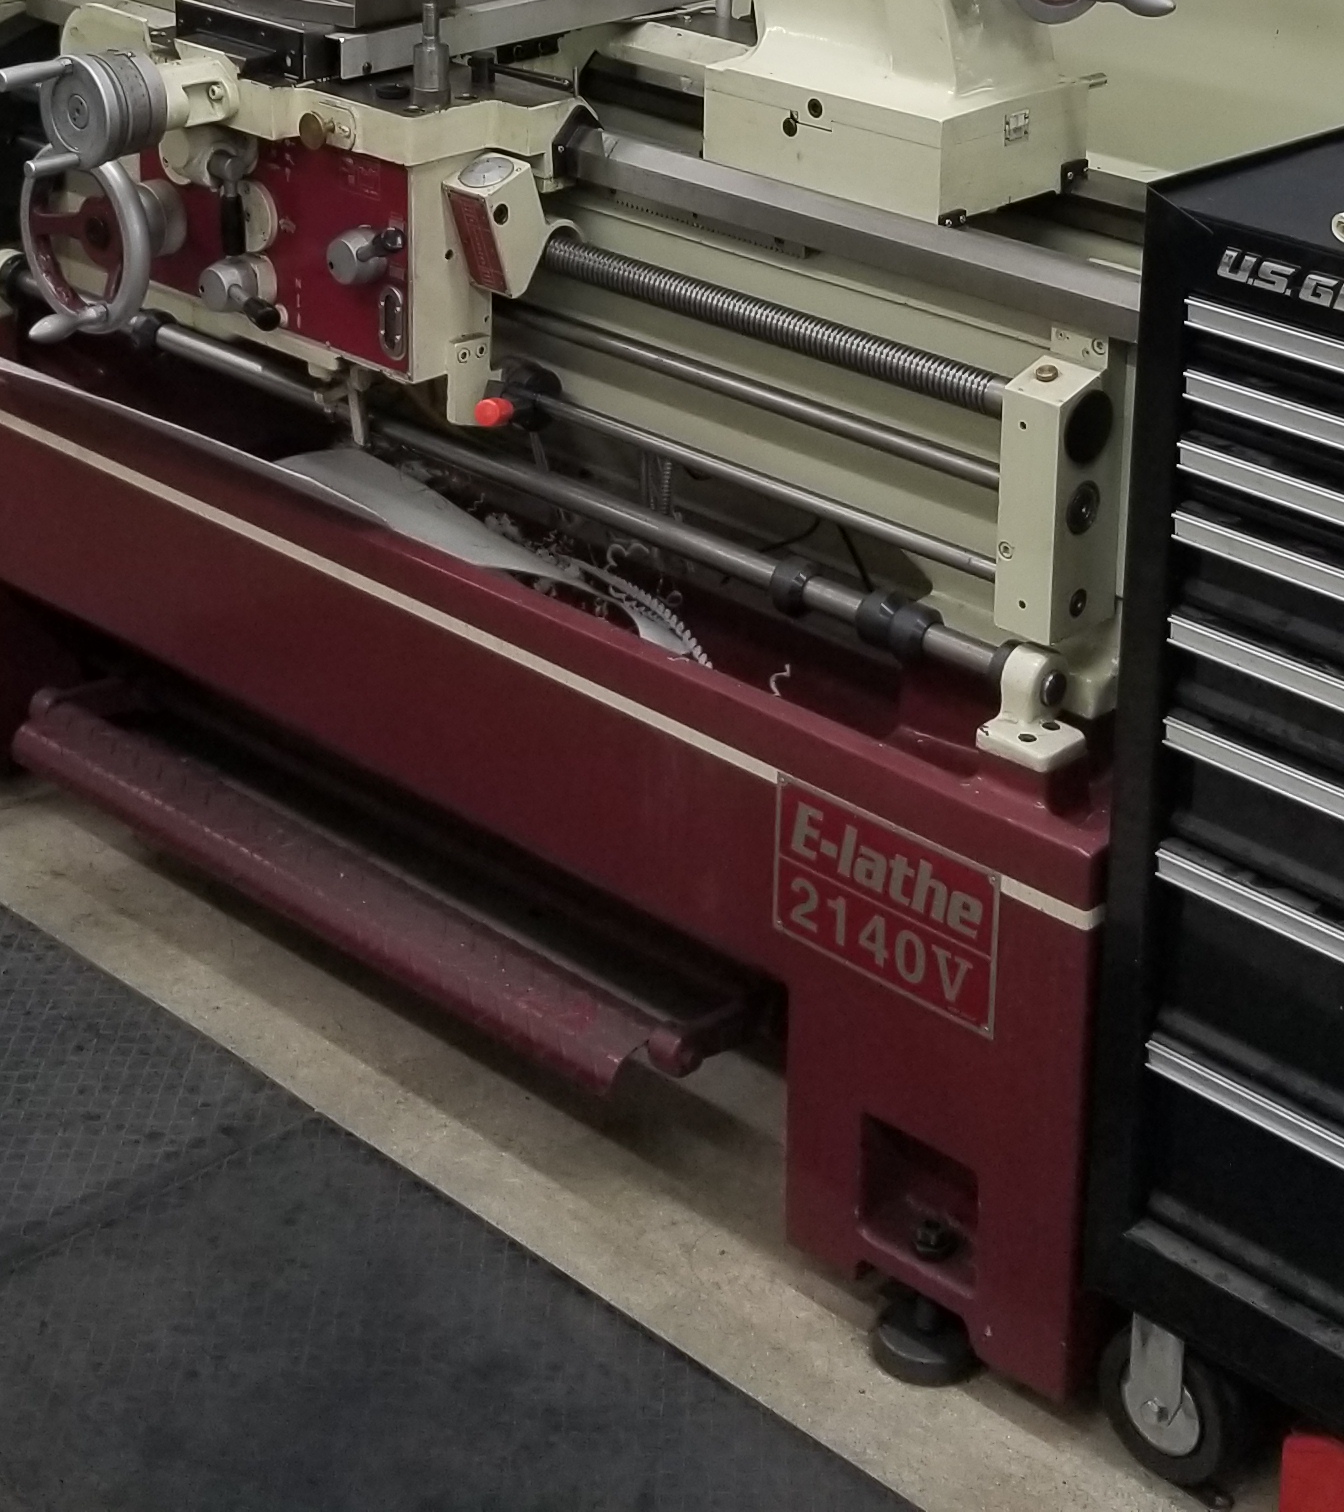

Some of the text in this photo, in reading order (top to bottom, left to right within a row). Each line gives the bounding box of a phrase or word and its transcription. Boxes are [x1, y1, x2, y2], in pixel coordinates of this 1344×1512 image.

[1217, 247, 1298, 296] U.S.
[790, 801, 984, 939] E-lathe
[790, 877, 974, 1002] 2140V
